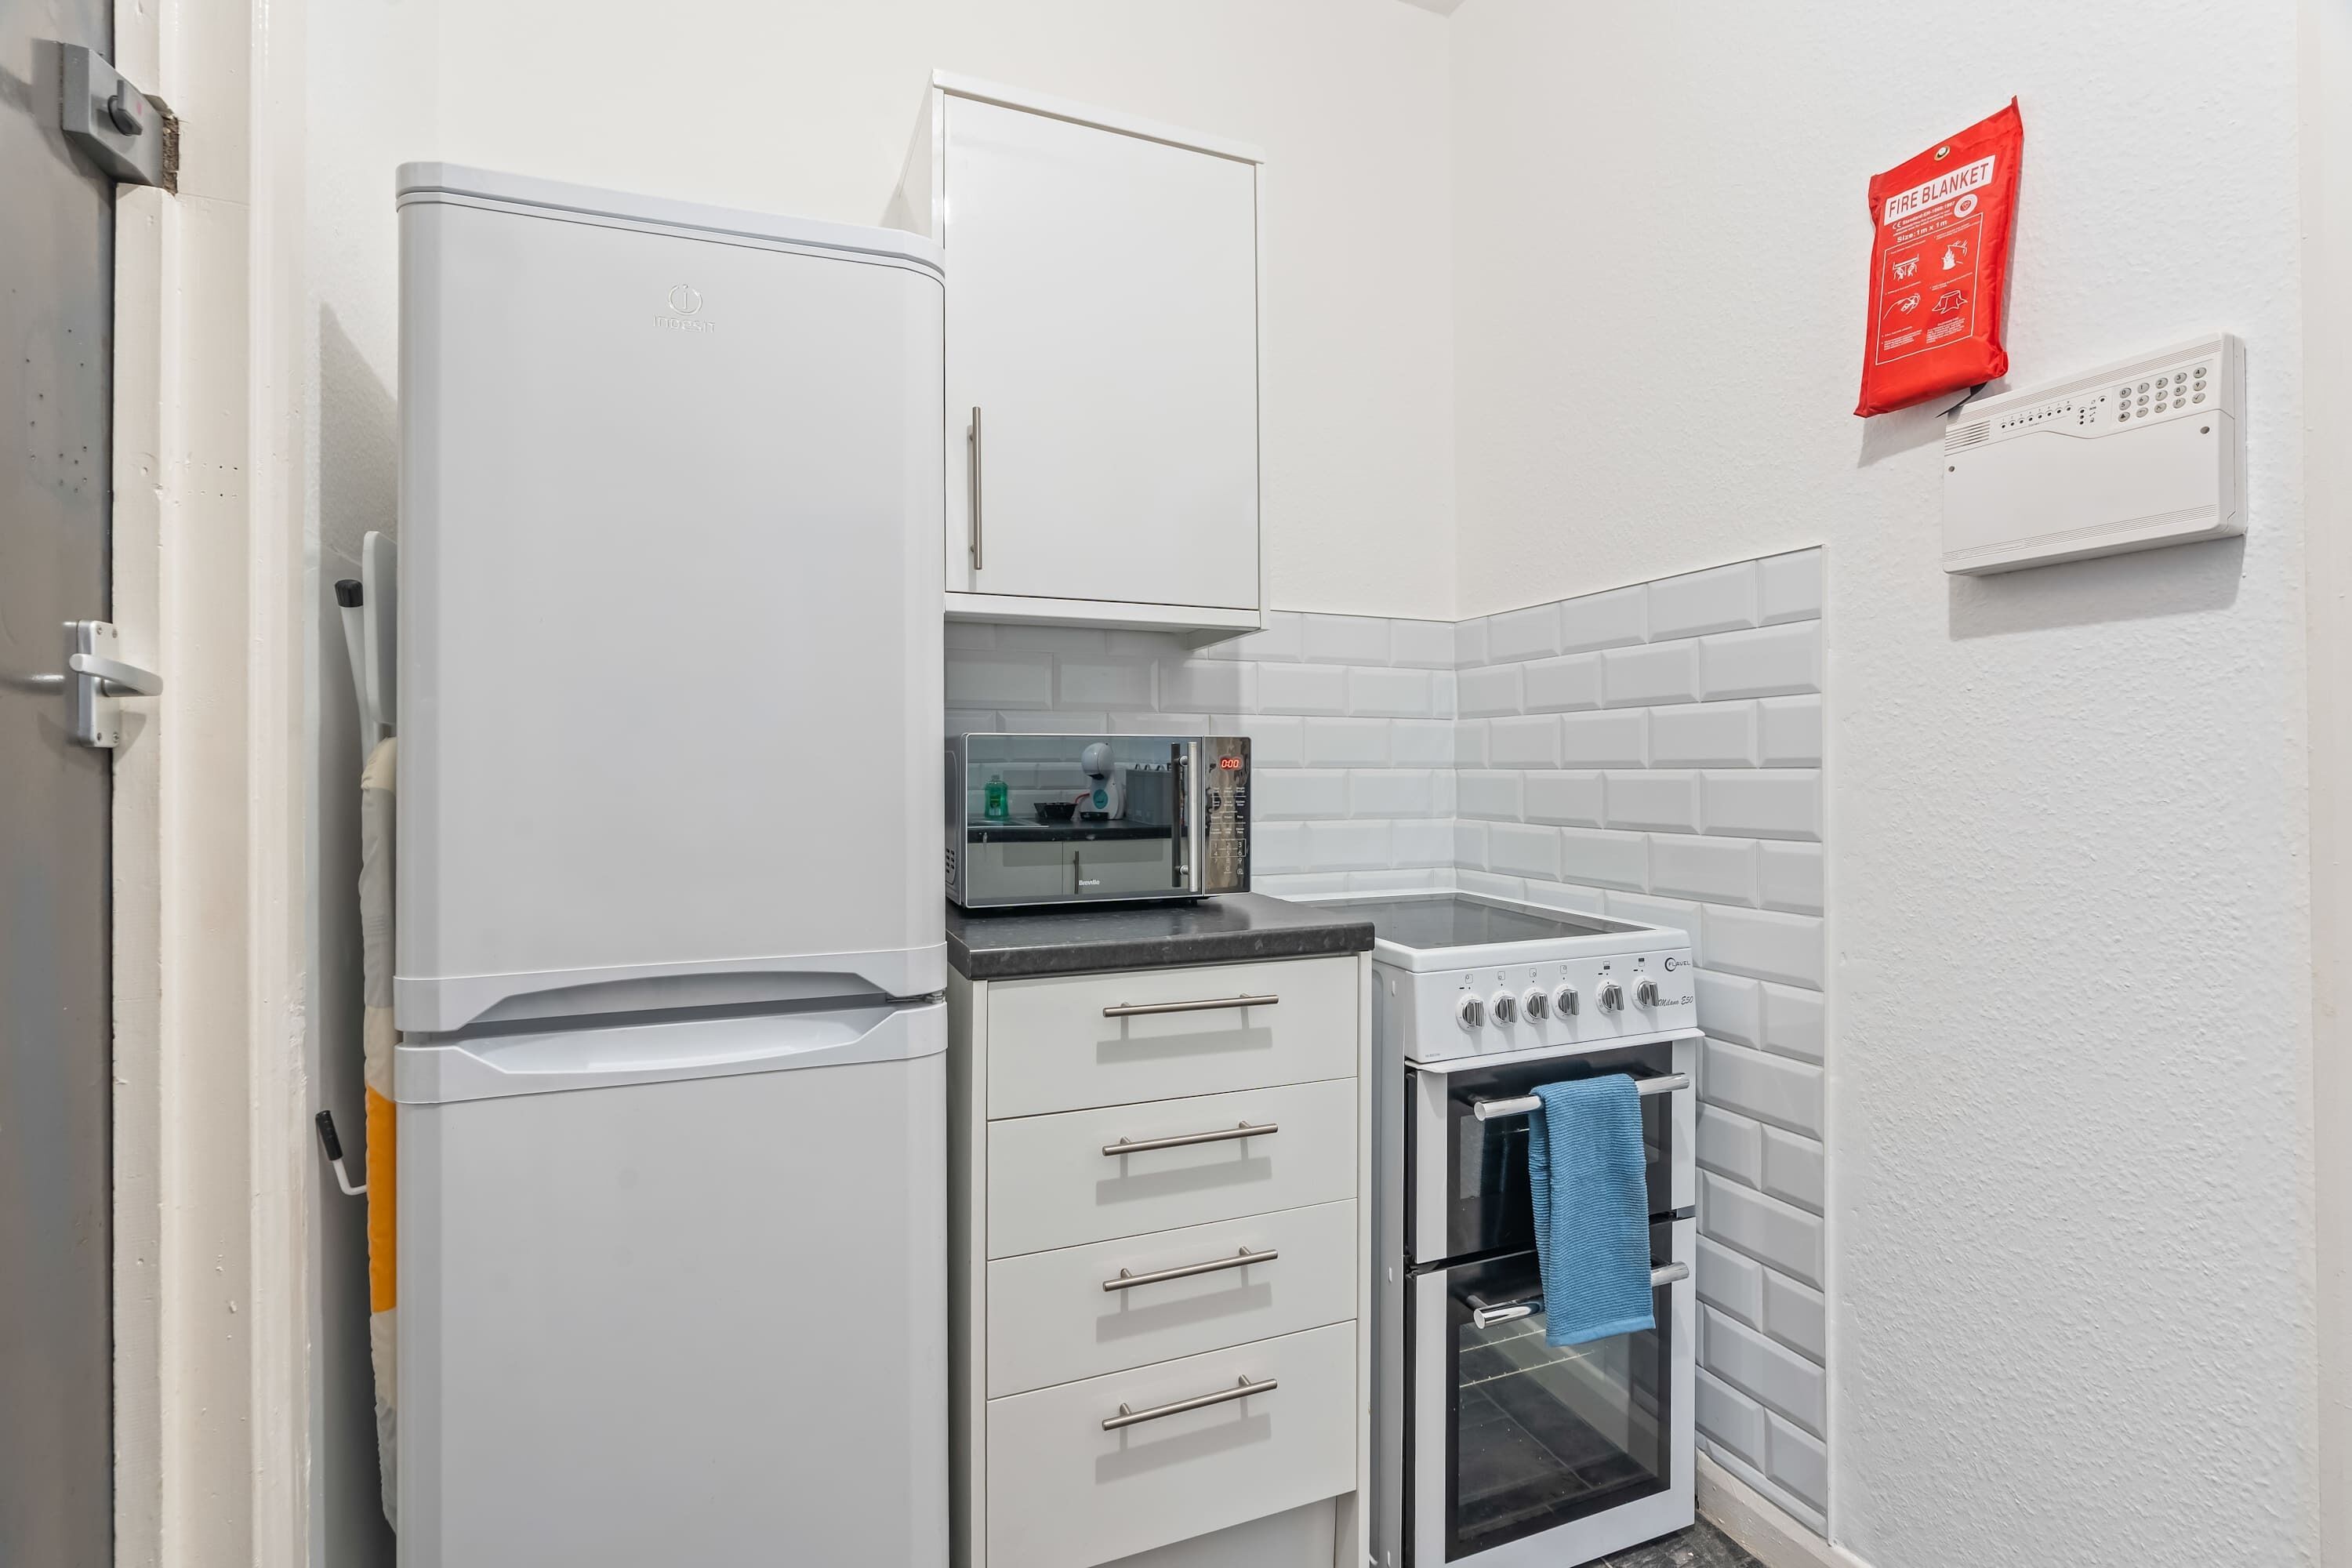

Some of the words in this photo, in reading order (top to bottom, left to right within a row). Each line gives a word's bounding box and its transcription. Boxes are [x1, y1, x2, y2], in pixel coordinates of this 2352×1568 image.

[1889, 191, 1918, 218] FIRE
[1922, 162, 1989, 204] BLANKET
[1221, 759, 1239, 768] 0:00
